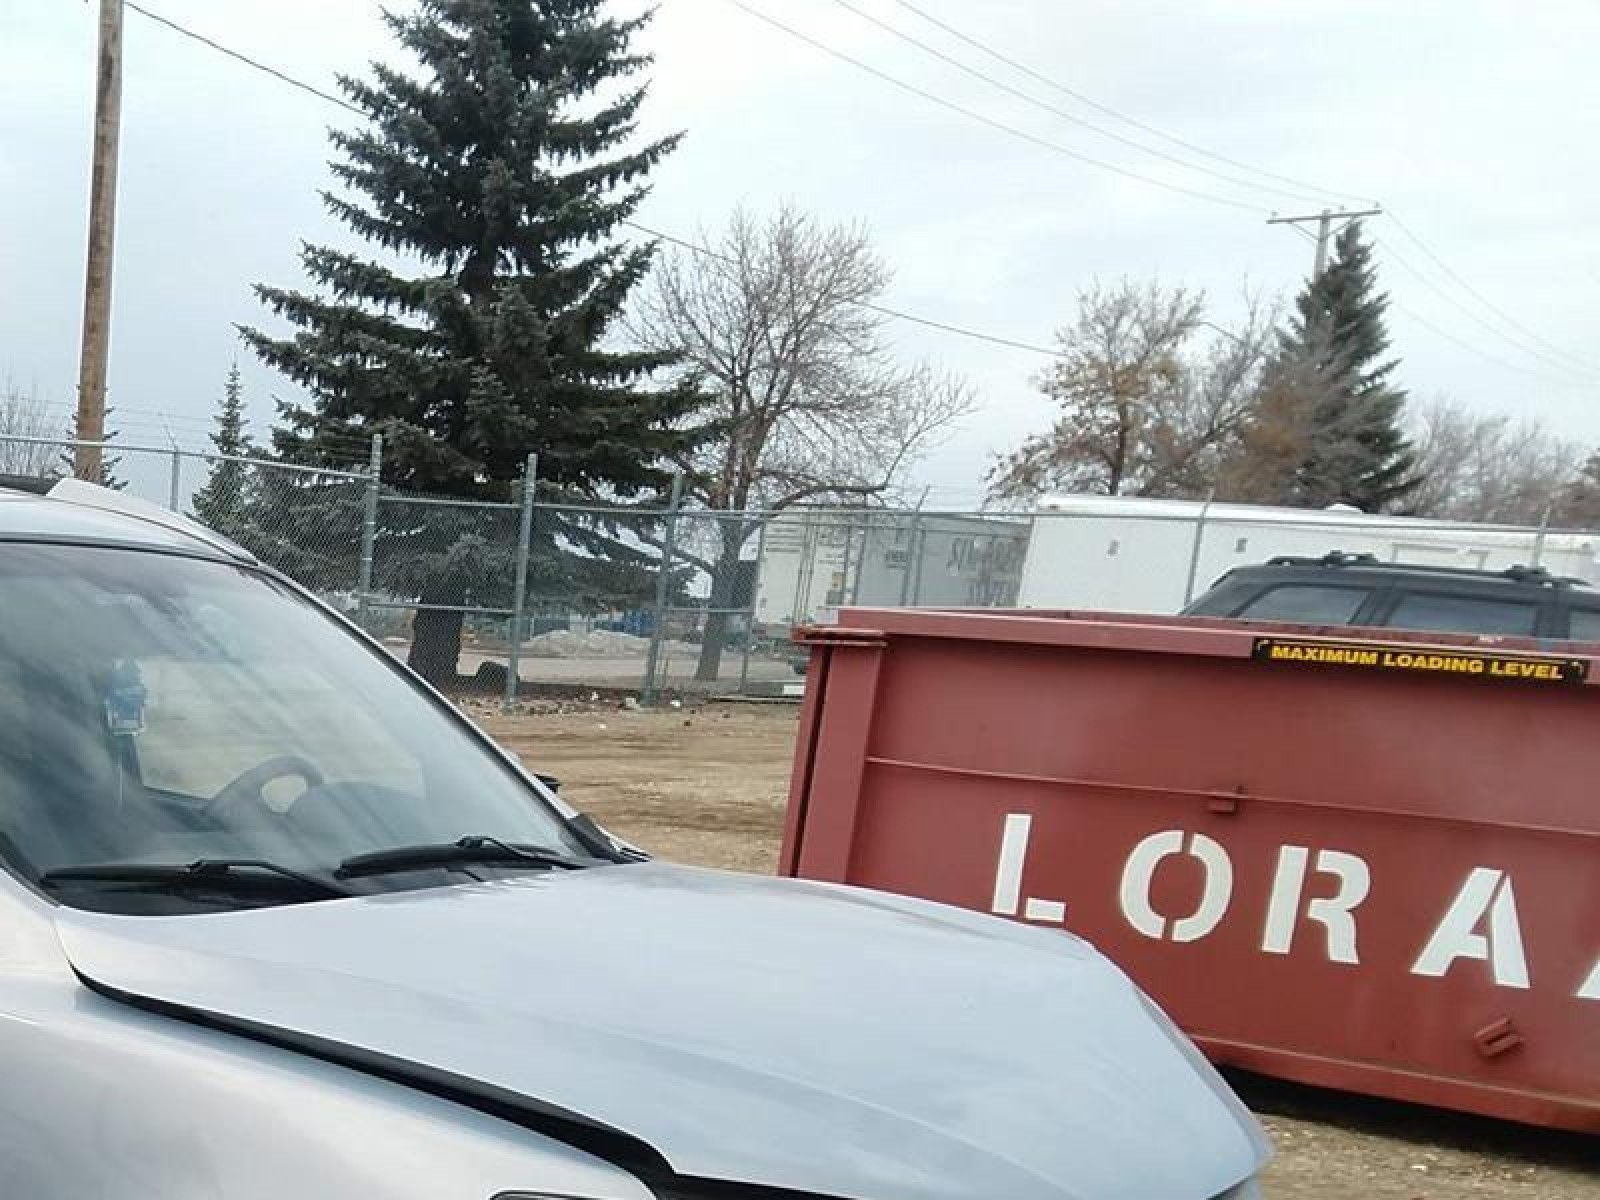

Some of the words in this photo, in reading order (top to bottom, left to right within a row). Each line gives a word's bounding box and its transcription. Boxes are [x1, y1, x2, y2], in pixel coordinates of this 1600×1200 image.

[1271, 645, 1377, 665] MAXIMUM
[1383, 653, 1483, 673] LOADING
[1491, 661, 1563, 679] LEVEL
[991, 813, 1600, 999] LORA
